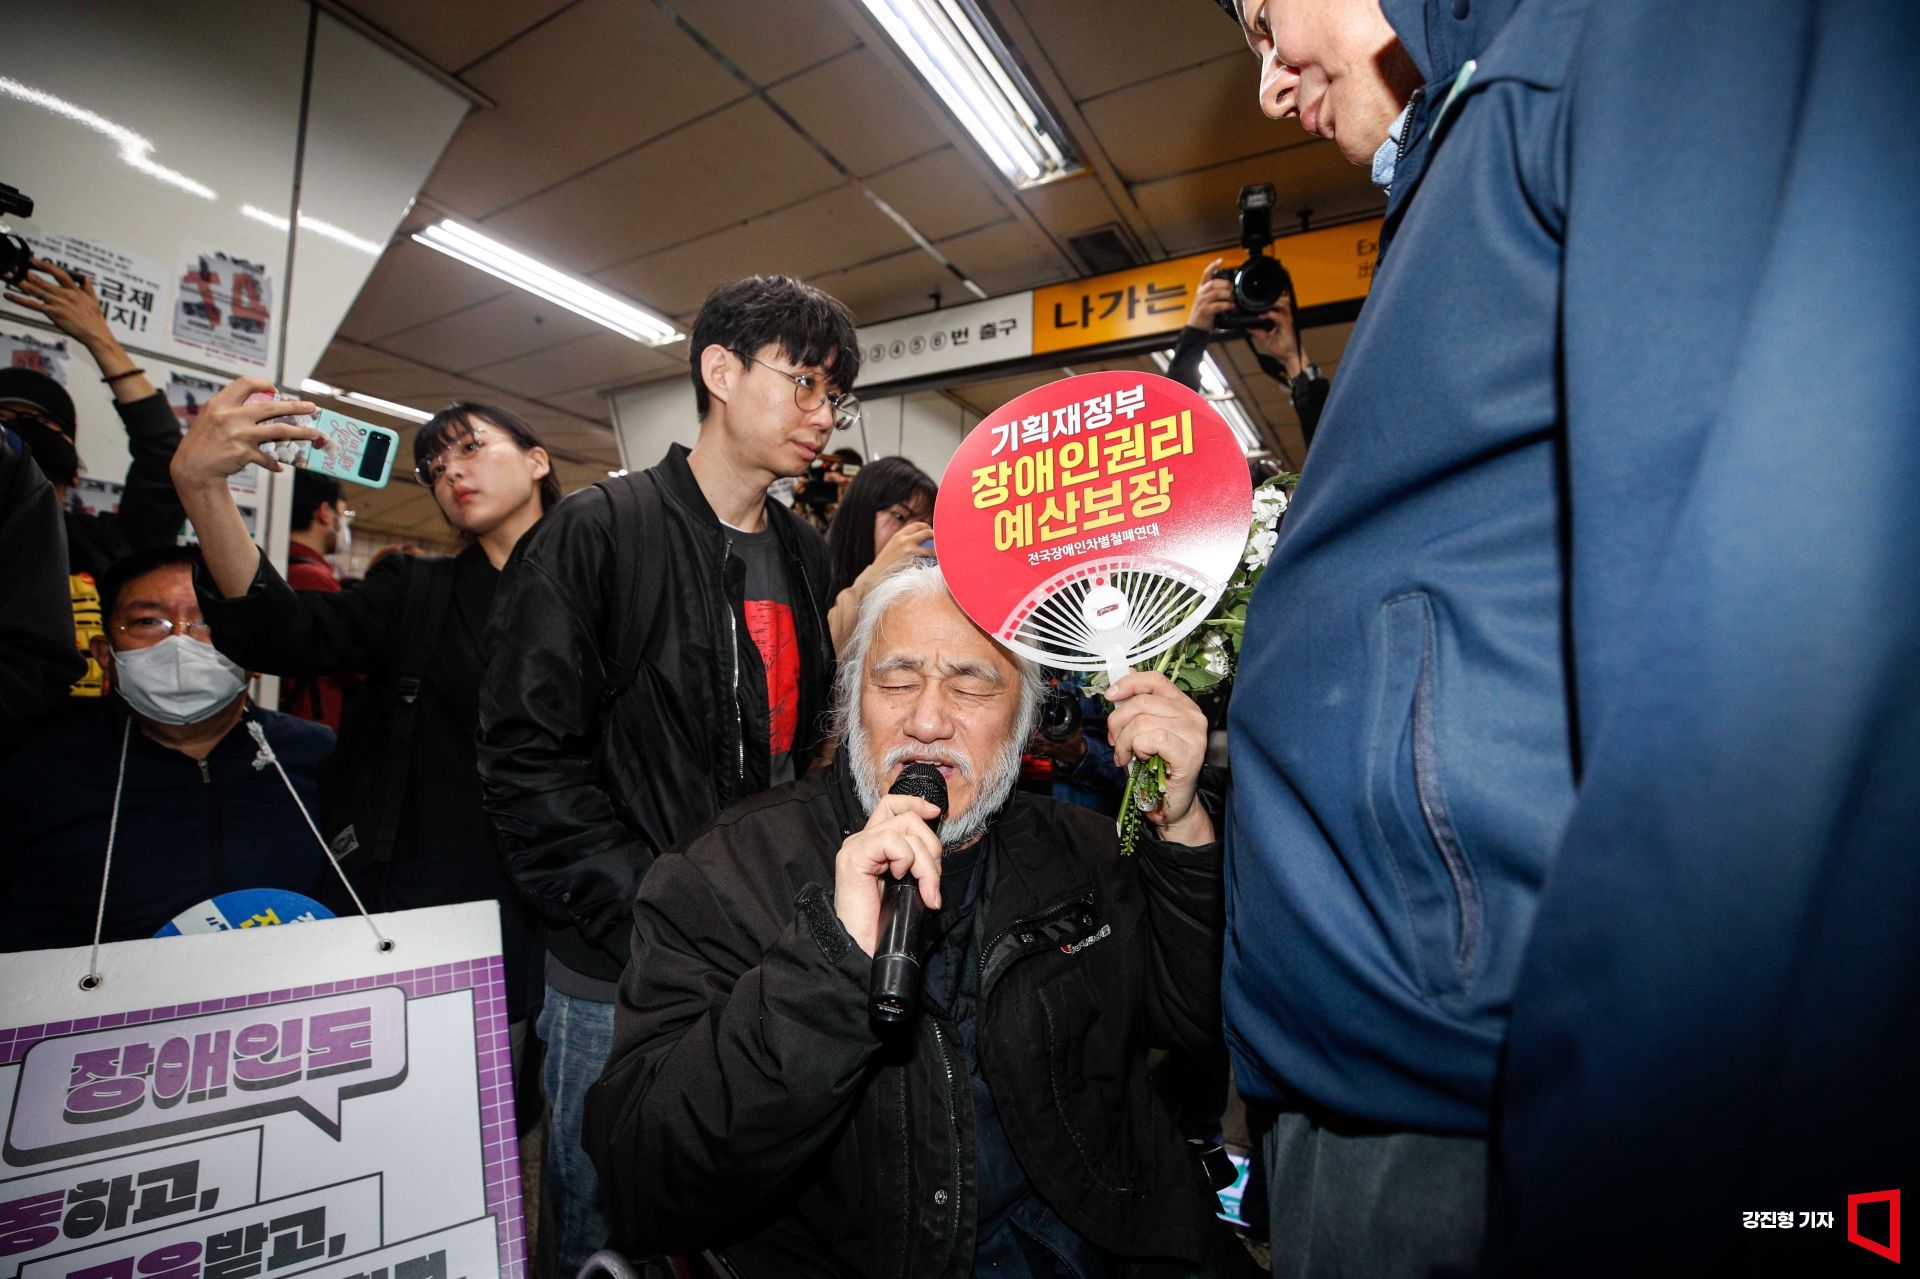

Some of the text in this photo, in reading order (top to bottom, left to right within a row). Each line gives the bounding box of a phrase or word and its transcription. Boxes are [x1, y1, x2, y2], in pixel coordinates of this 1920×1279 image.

[979, 317, 1018, 341] 출구
[1054, 282, 1188, 329] 나가는
[991, 383, 1146, 457] 기획재정부
[971, 409, 1194, 510] 장애인권리
[993, 466, 1174, 552] 예산보장
[1027, 522, 1161, 567] 전국장애인차별철폐연대
[62, 1006, 373, 1125] 장애인도
